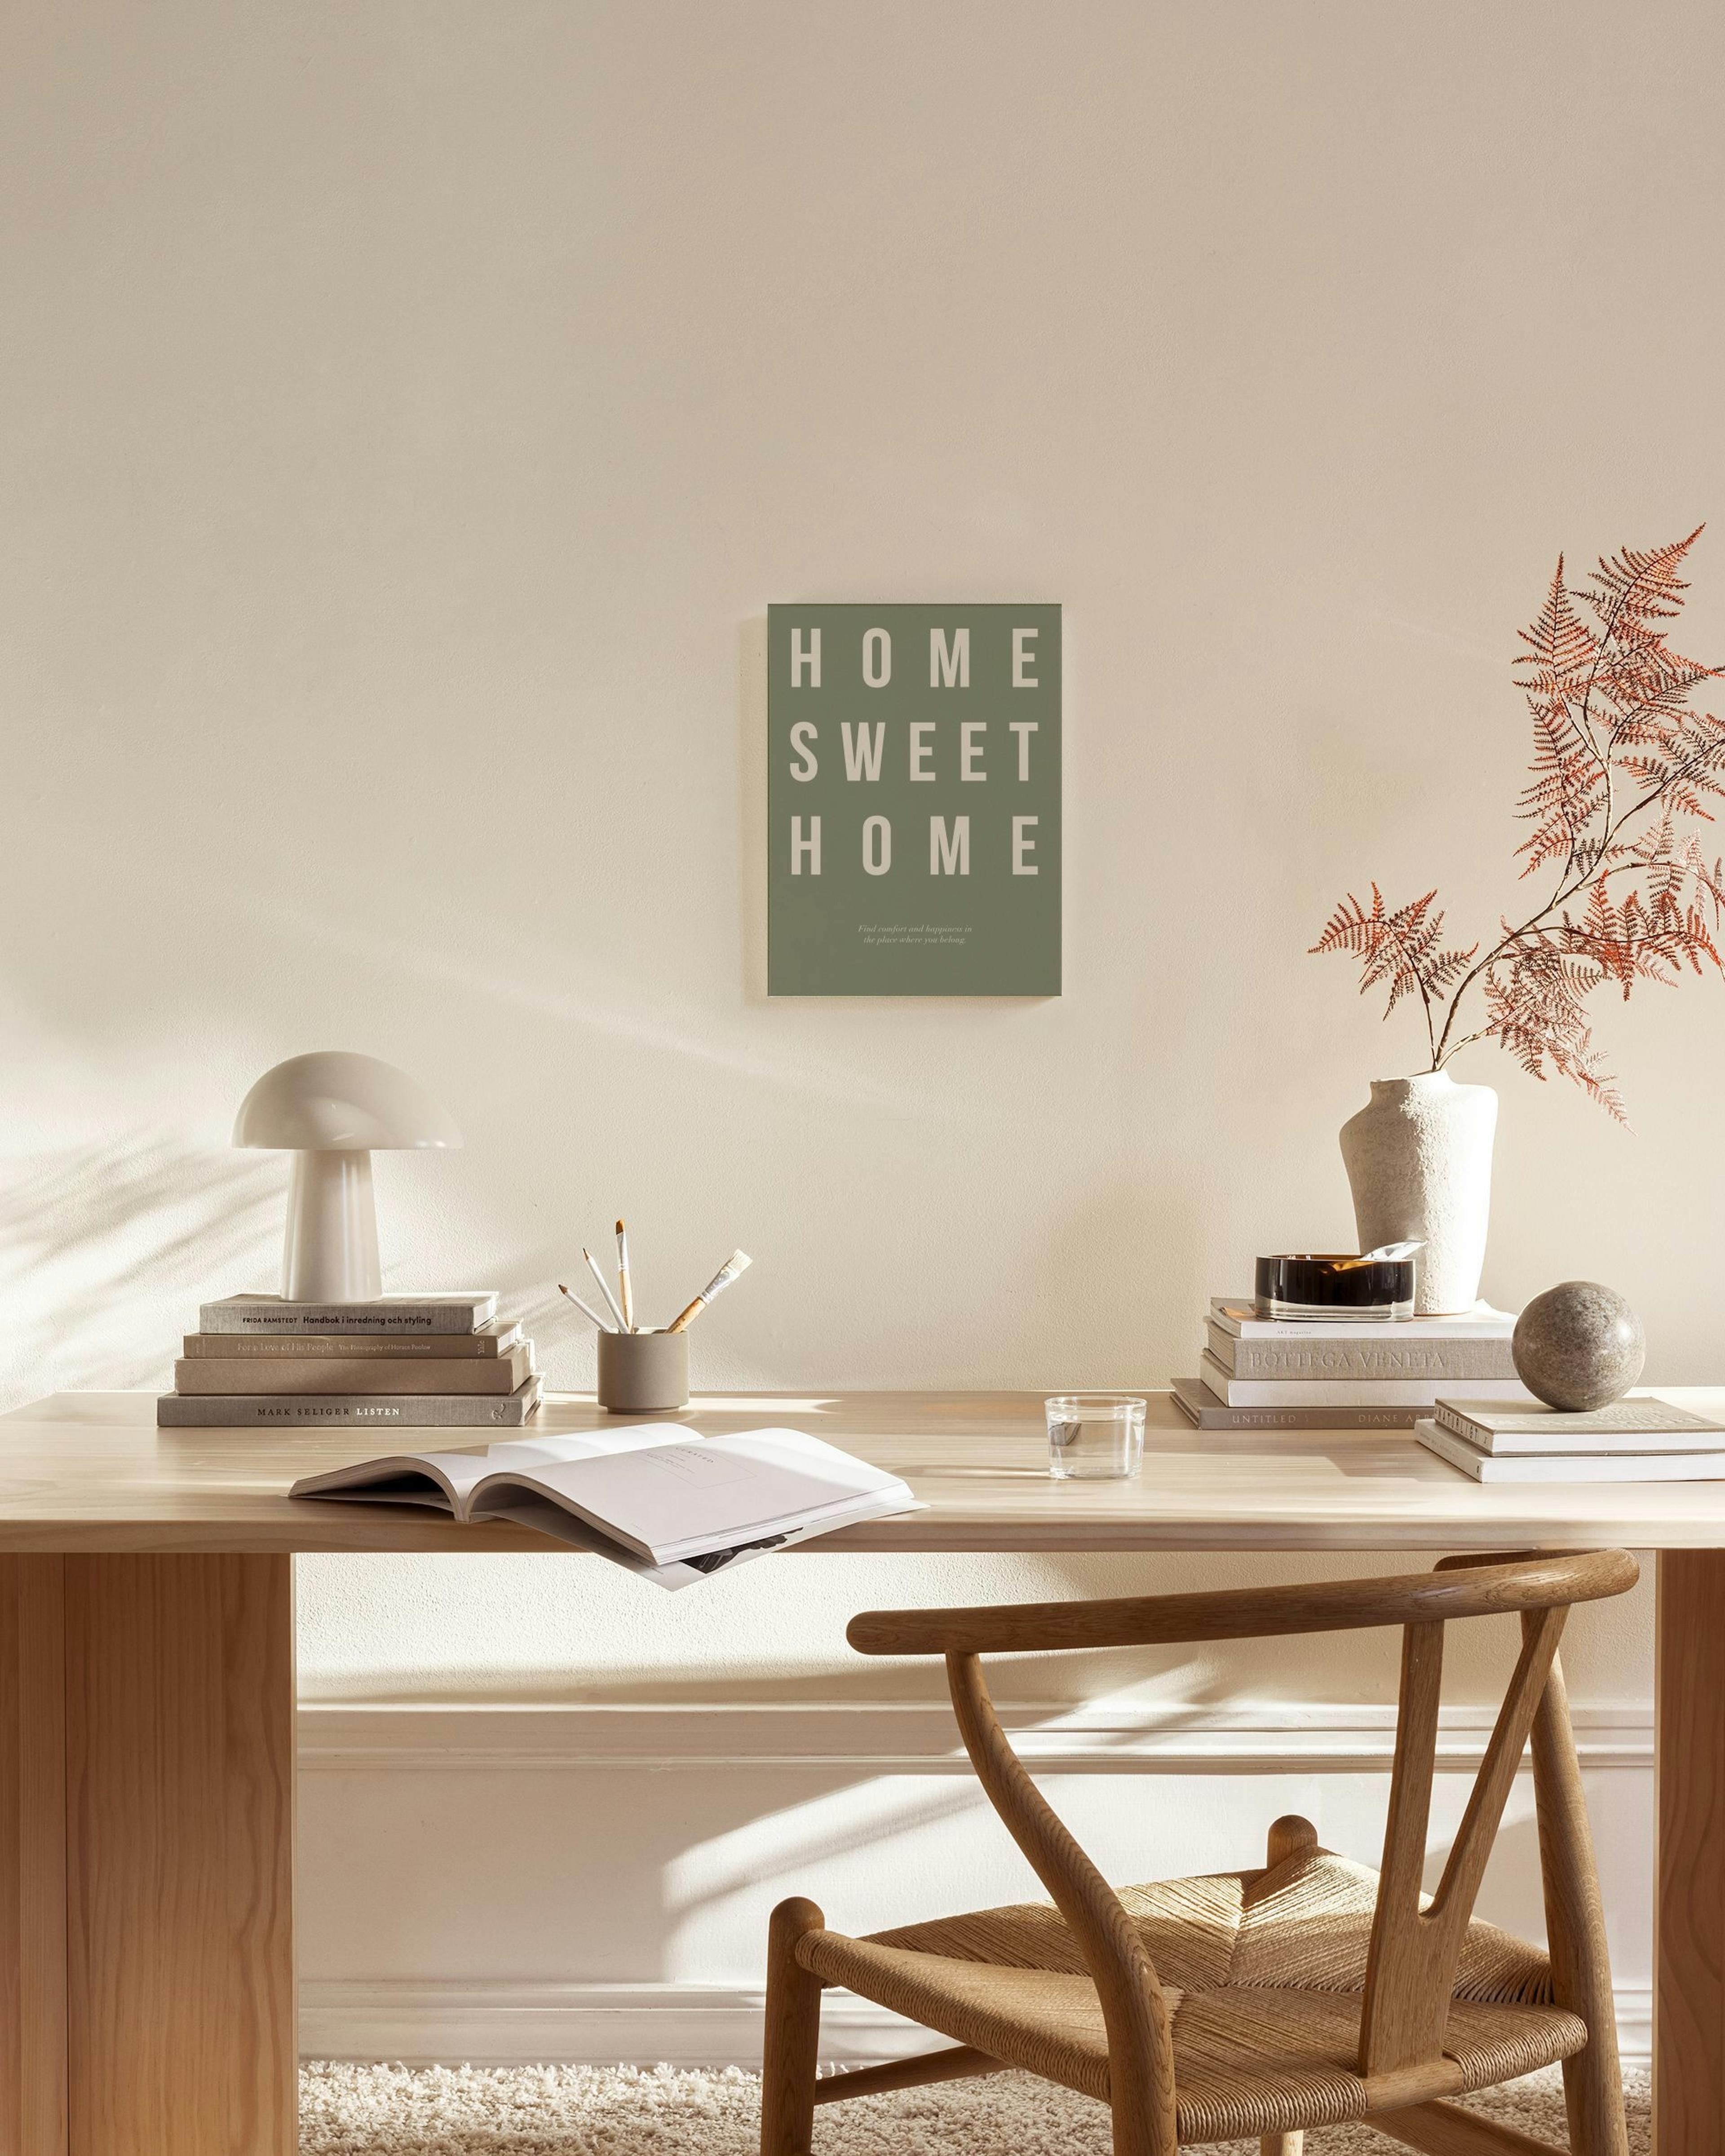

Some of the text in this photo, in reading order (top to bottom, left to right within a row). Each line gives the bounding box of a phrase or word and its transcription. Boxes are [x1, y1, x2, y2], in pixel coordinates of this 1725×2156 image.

[791, 627, 1038, 688] HOME
[790, 721, 1038, 782] SWEET
[791, 815, 1038, 876] HOME
[858, 924, 972, 935] Find comfort and happiness in
[863, 935, 967, 946] the place where you belong.
[346, 1316, 385, 1326] inredning
[404, 1316, 432, 1325] styling
[261, 1343, 279, 1352] Love
[307, 1343, 334, 1353] People
[1250, 1352, 1446, 1367] BOTTEGA VENETA
[356, 1408, 400, 1416] LISTEN
[1232, 1414, 1296, 1423] UNTITLED
[1358, 1414, 1398, 1423] DIANE
